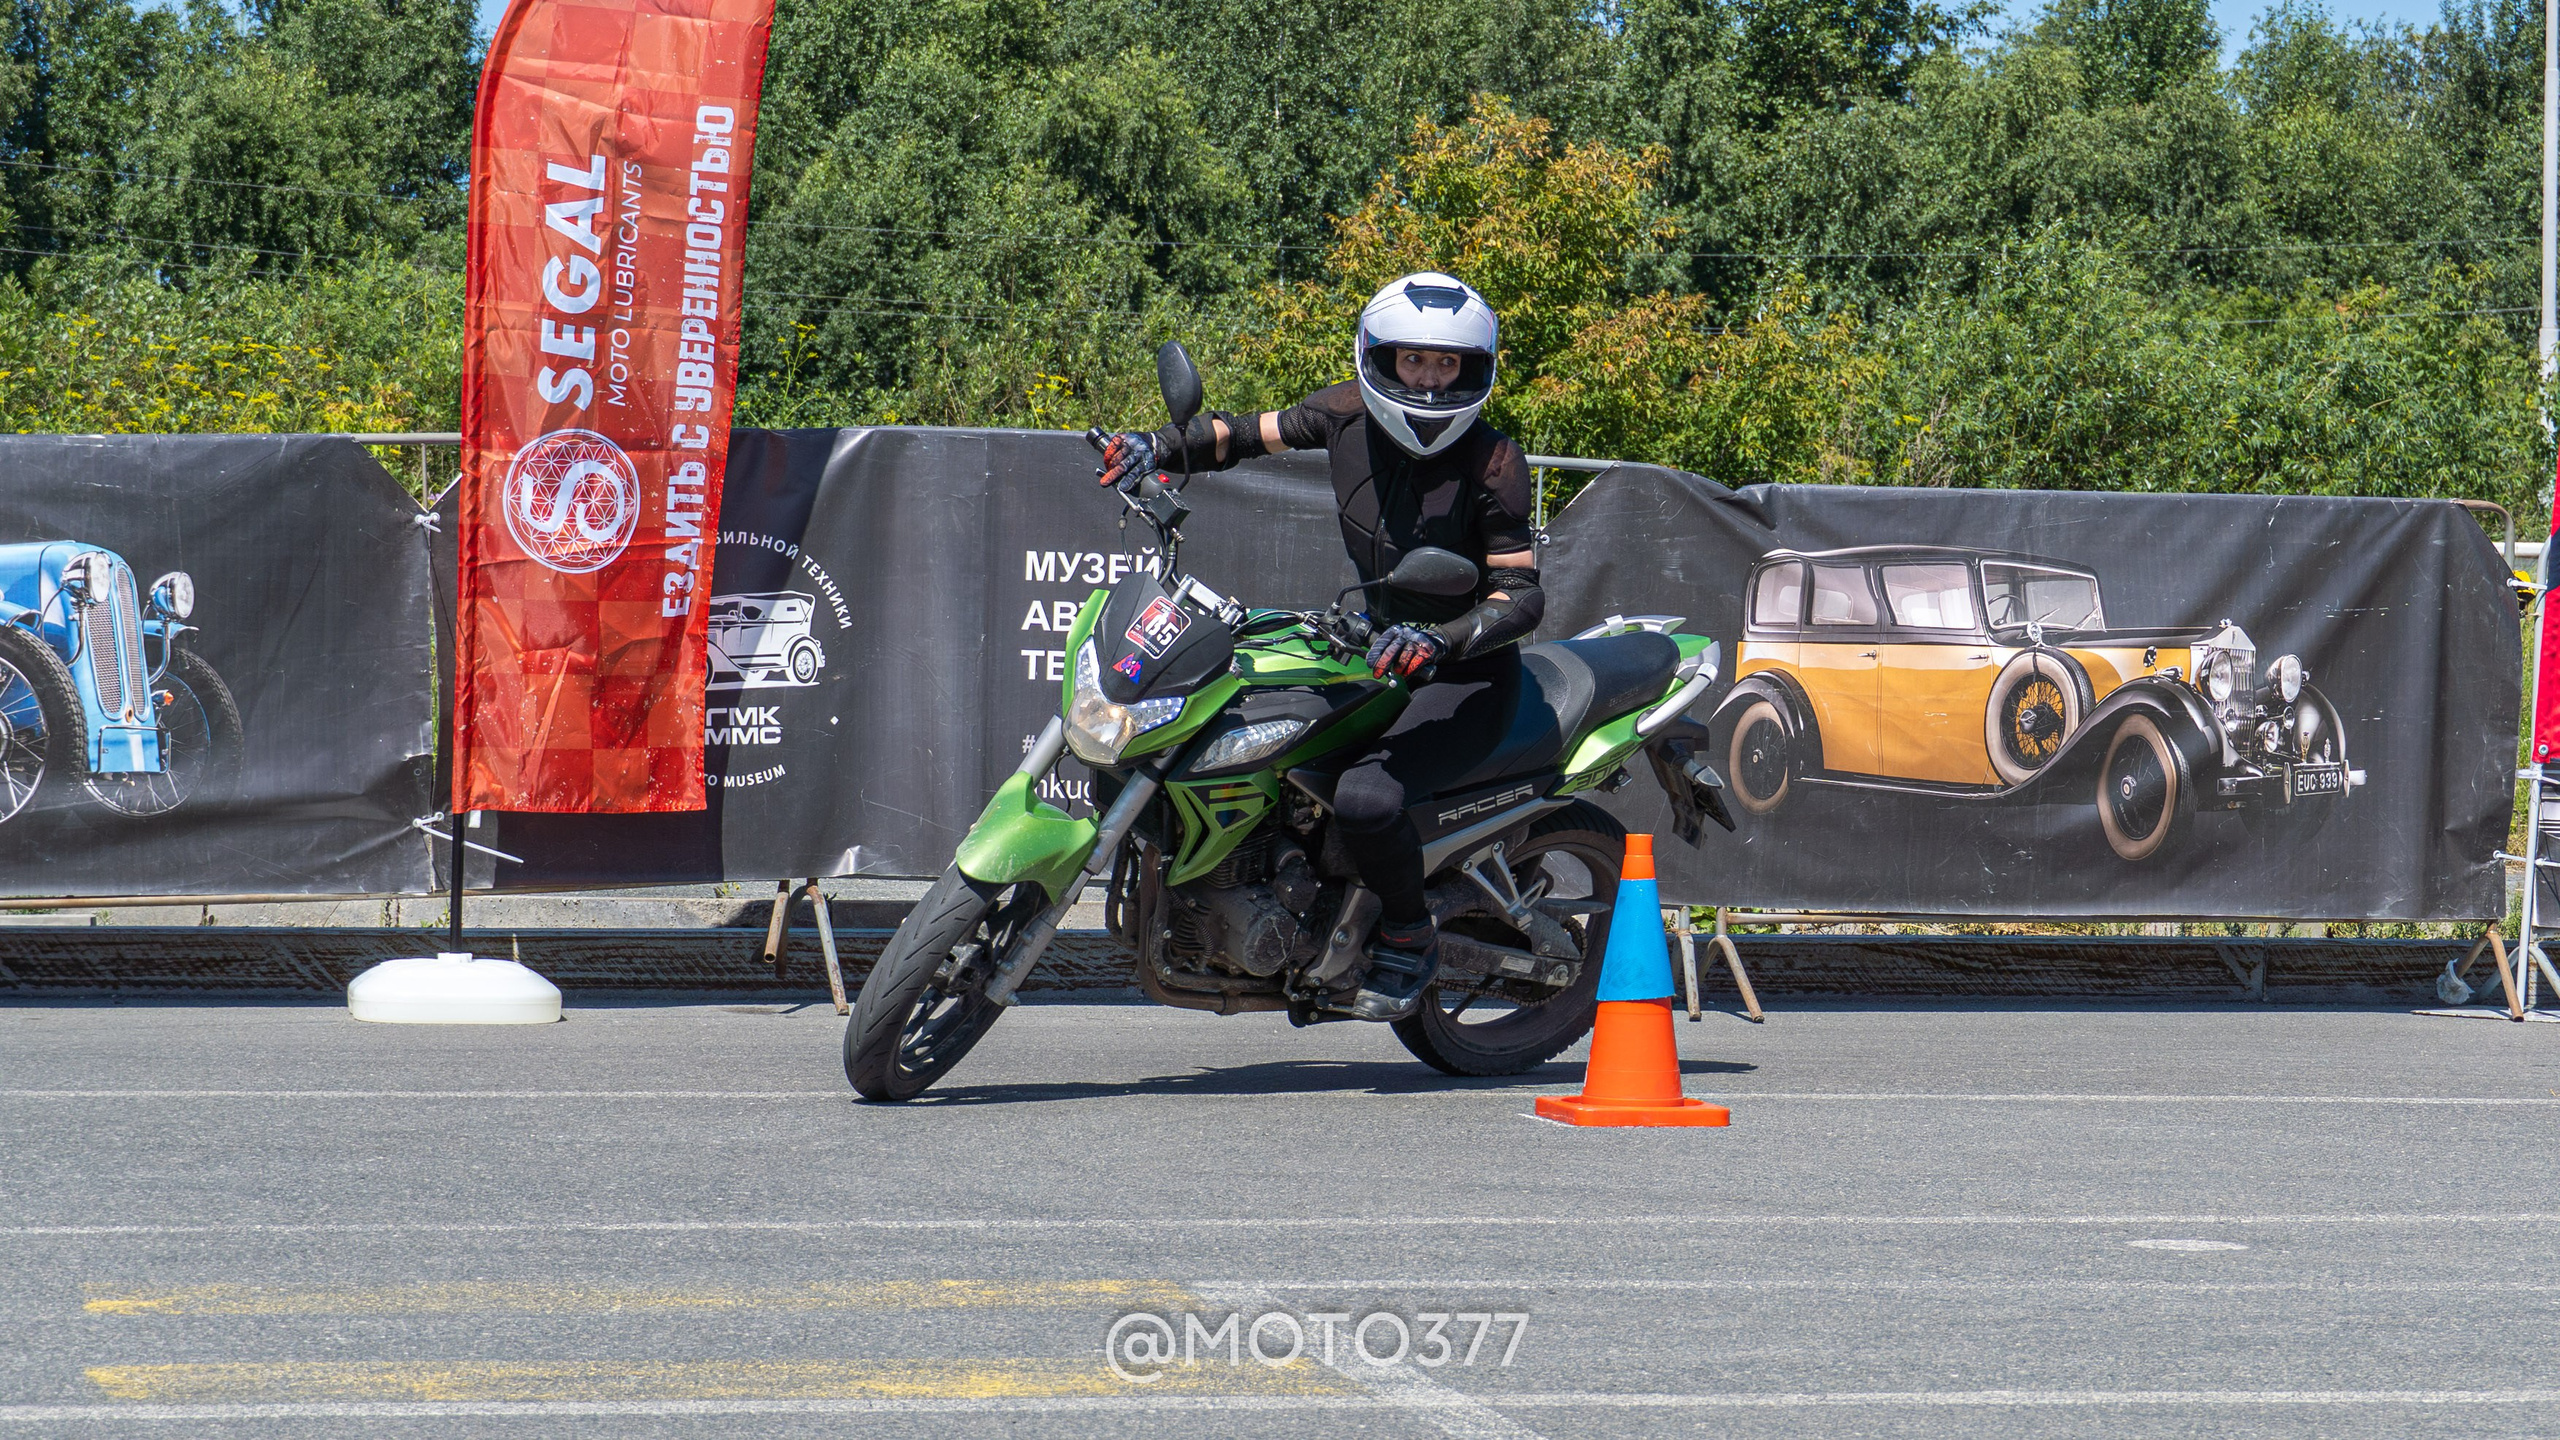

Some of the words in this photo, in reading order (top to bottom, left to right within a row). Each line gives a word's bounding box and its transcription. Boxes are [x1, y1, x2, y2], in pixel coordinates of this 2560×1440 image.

[614, 160, 643, 322] LUBRICANTS
[674, 105, 735, 412] УВЕРЕННОСТЬЮ
[537, 154, 606, 411] SEGAL
[608, 328, 631, 406] MOTO
[672, 424, 710, 449] С
[662, 461, 707, 618] ЕЗДИТЬ
[1025, 547, 1161, 584] МУЗЕЙ
[801, 555, 853, 630] ТЕХНИКИ
[1021, 600, 1086, 632] АВ
[723, 764, 786, 788] MUSEUM
[1438, 784, 1534, 826] RACER
[2297, 773, 2317, 792] EUC
[2319, 772, 2338, 790] 939
